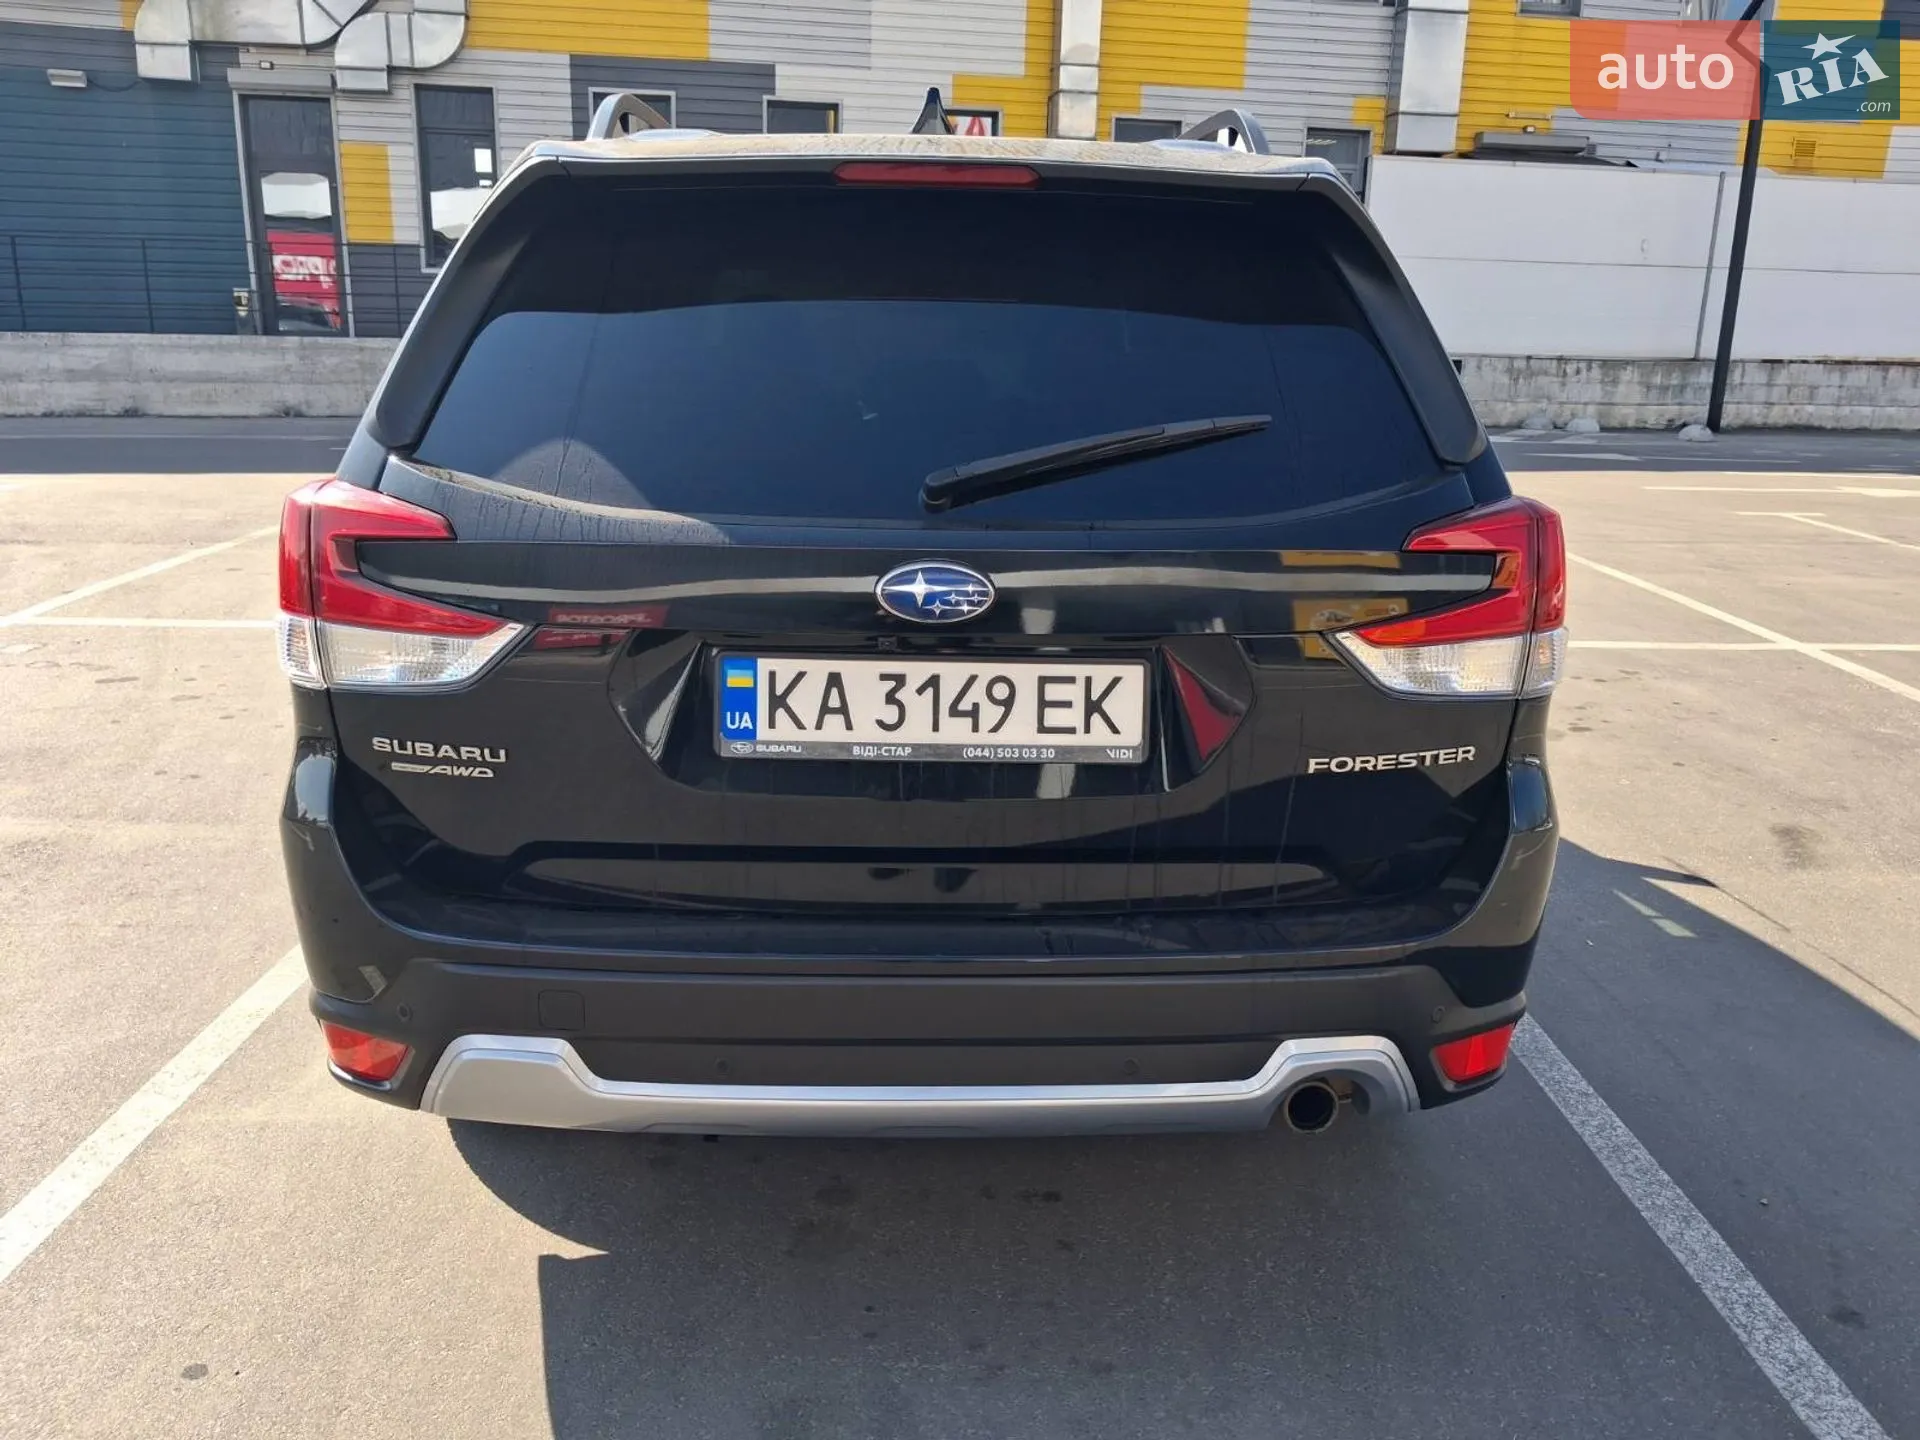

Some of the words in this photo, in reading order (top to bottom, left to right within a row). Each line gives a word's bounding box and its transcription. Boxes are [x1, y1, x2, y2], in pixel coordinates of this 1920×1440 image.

[768, 670, 854, 731] KA
[875, 673, 1017, 735] 3149
[1036, 675, 1124, 735] EK
[726, 711, 754, 730] UA
[372, 736, 507, 763] SUBARU
[755, 744, 802, 753] SUBARU
[852, 745, 913, 757] ВІДІ-СТАР
[963, 747, 995, 759] (044)
[997, 748, 1019, 758] 503
[1022, 749, 1037, 758] 03
[1039, 749, 1056, 759] 30
[1105, 748, 1133, 759] VIDI
[1307, 745, 1477, 774] FORESTER
[427, 764, 495, 778] AWD
